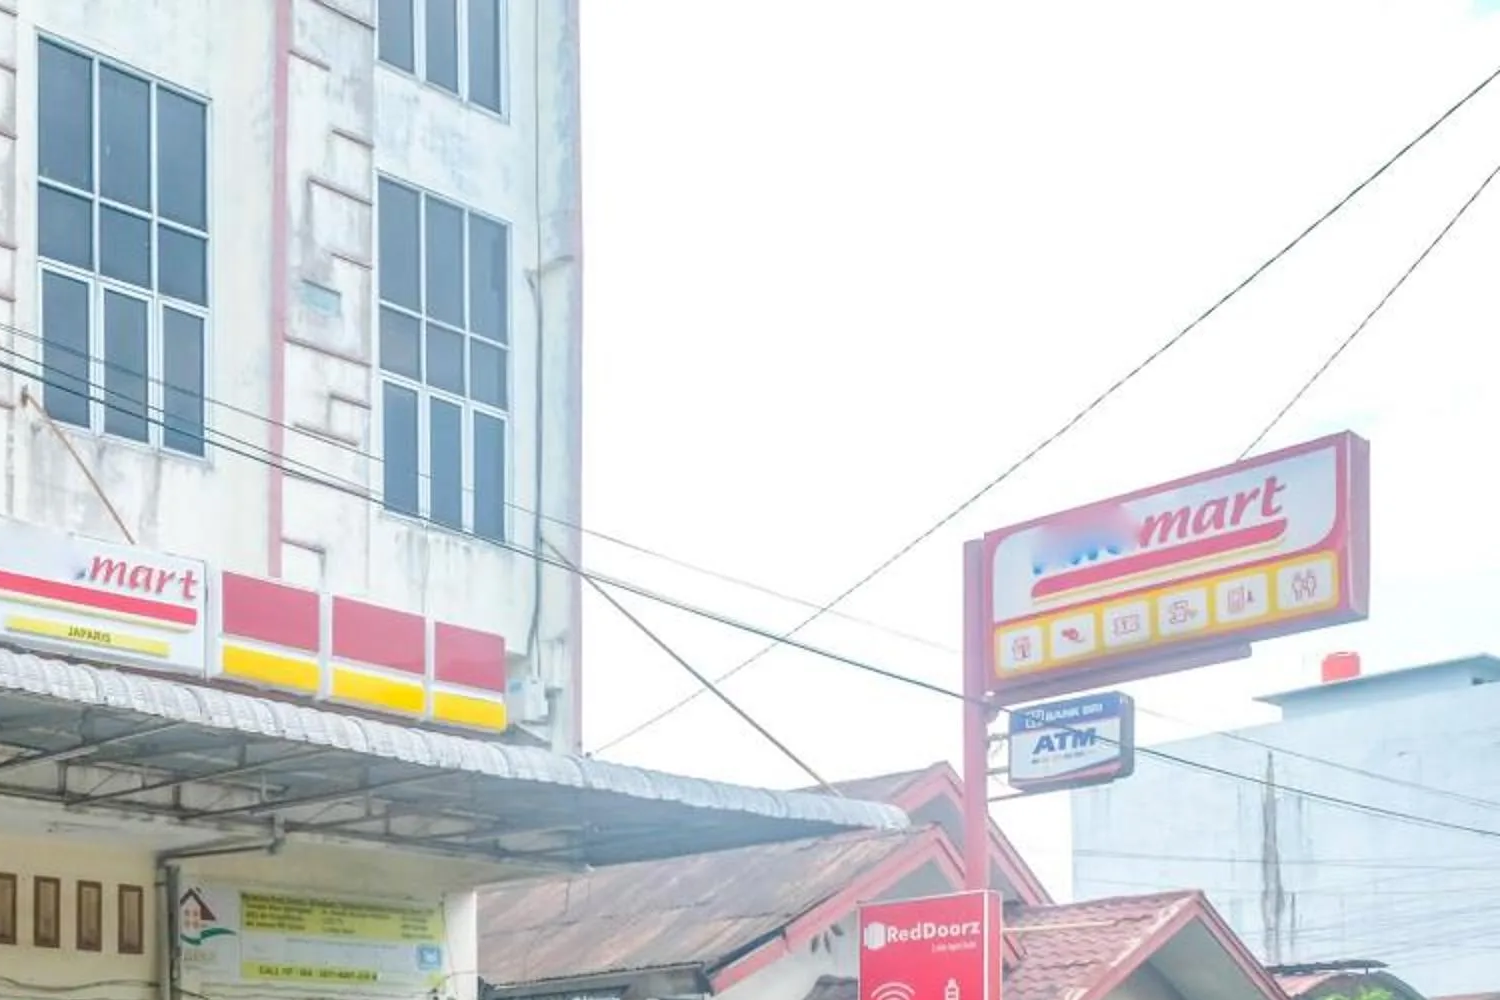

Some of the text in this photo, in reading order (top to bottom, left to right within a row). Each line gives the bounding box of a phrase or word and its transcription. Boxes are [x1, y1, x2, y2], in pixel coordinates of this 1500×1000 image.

[1137, 475, 1287, 548] mart
[88, 554, 199, 601] mart
[1031, 727, 1097, 755] ATM
[886, 921, 982, 943] RedDoorz
